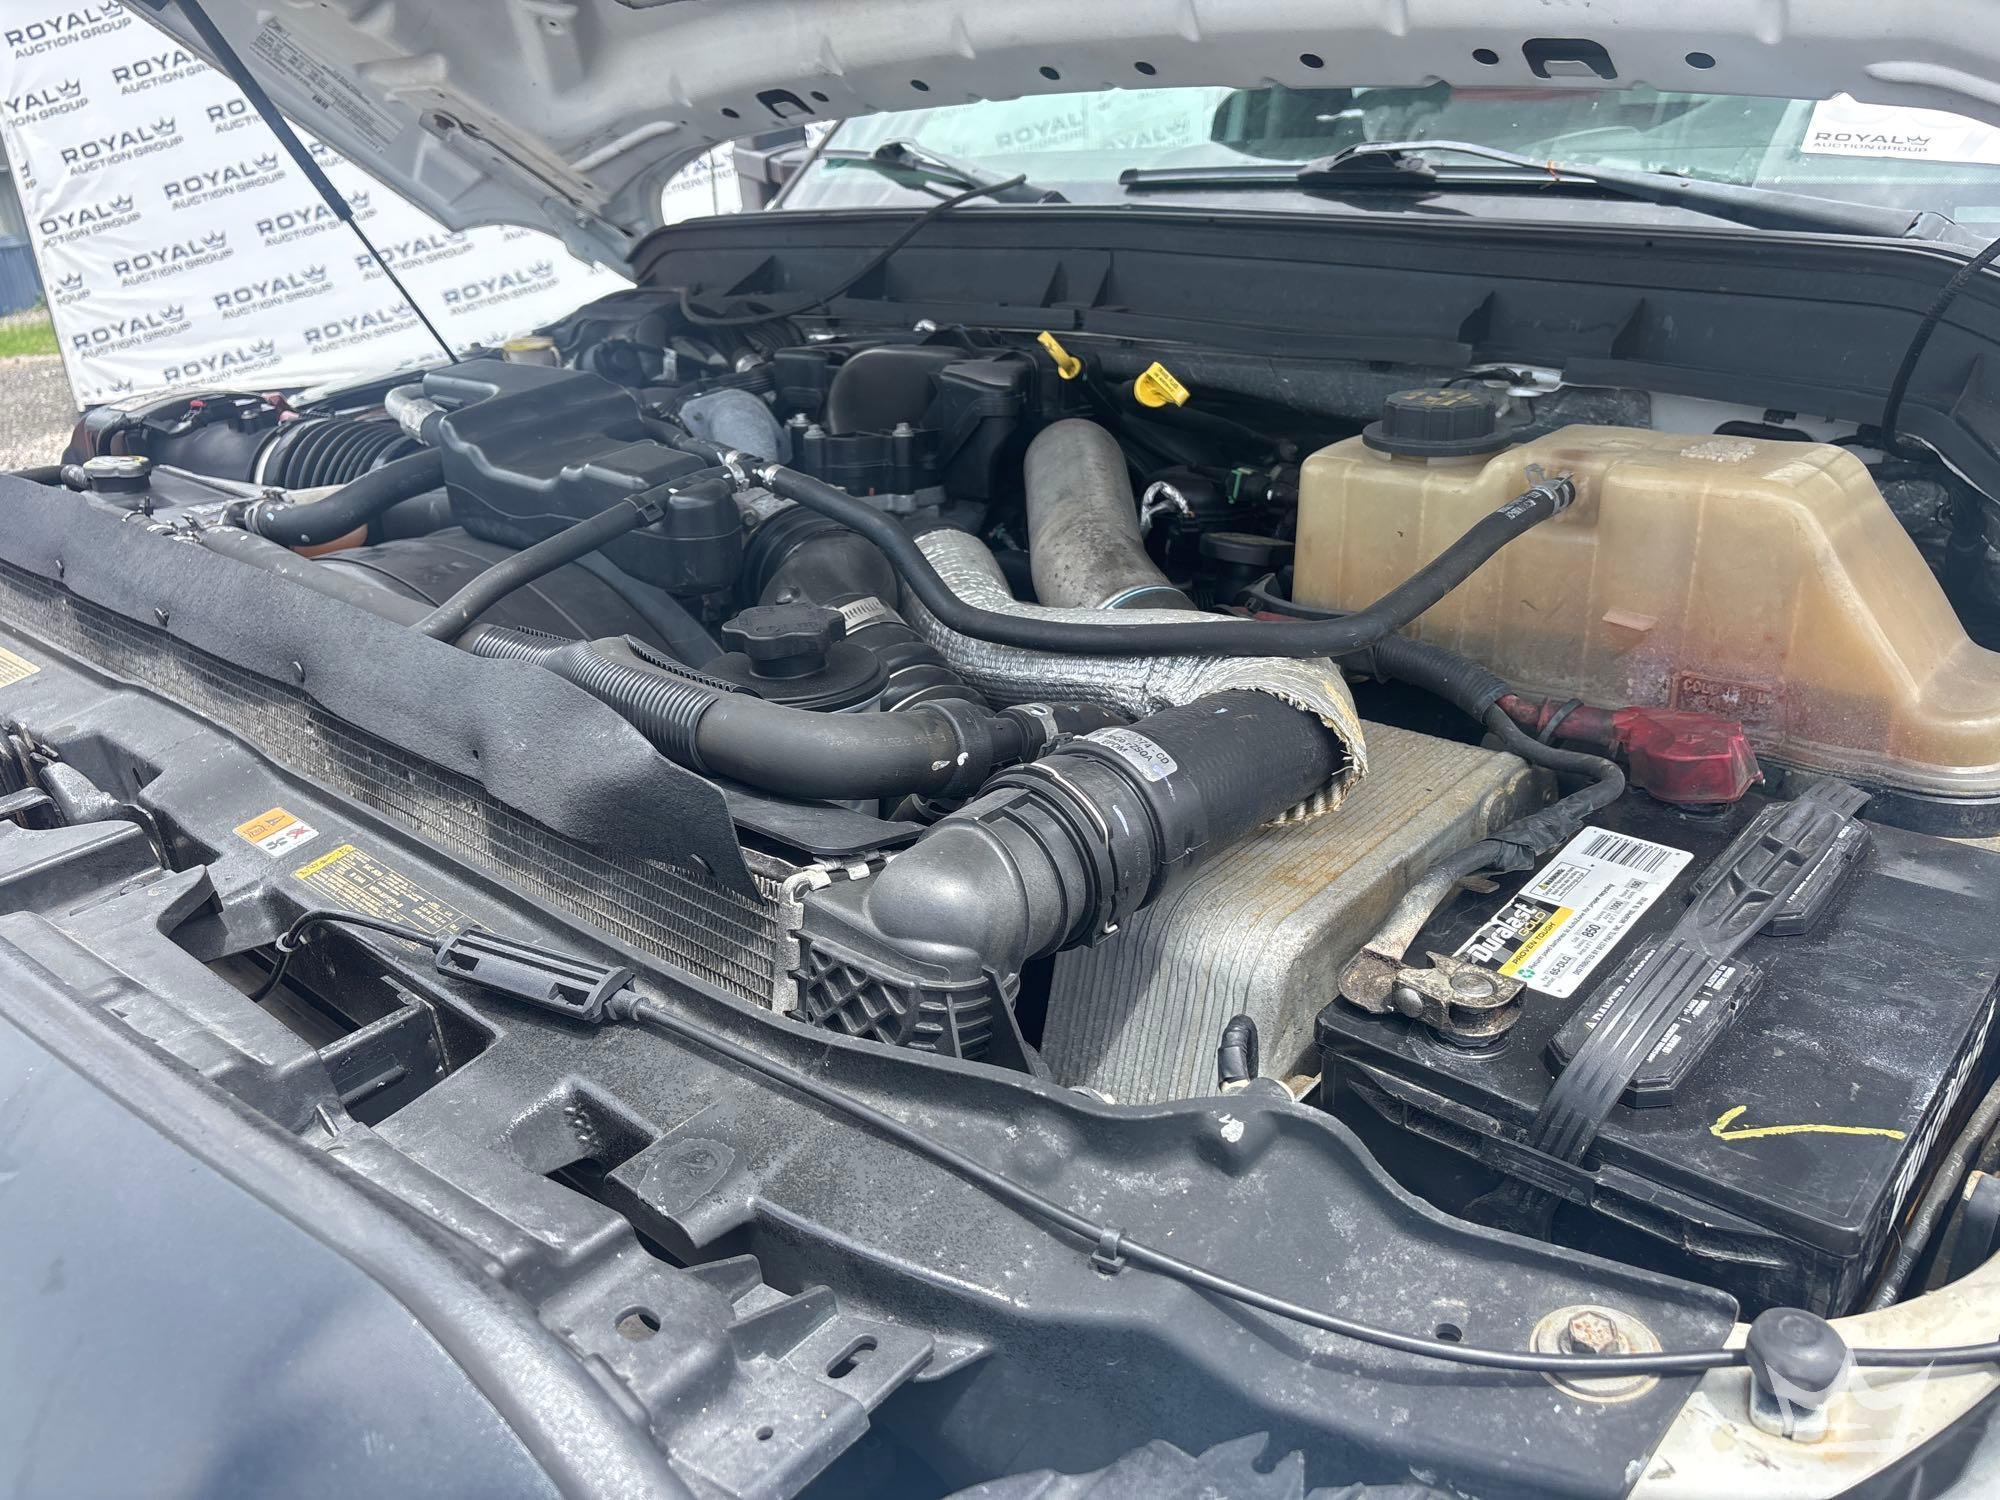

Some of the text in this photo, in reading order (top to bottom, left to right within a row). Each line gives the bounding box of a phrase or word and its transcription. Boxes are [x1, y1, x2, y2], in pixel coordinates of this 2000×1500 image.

[5, 8, 100, 47] ROYAL
[15, 17, 132, 59] AUCTION GROUP
[112, 50, 200, 83] ROYA
[121, 69, 184, 96] AUCTION
[5, 88, 59, 114] YAL
[39, 97, 89, 121] GROUP
[61, 126, 154, 165] ROYAL
[1813, 142, 1928, 153] AUCTION GROUP
[1815, 132, 1904, 144] ROYAL
[70, 135, 184, 176] AUCTION GROUP
[163, 162, 256, 200] ROYAL
[172, 184, 235, 211] AUCTION
[40, 204, 112, 236] OYAL
[256, 203, 332, 236] ROYA
[113, 240, 205, 277] ROYAL
[355, 234, 446, 271] ROYAL
[122, 262, 183, 288] AUCTION
[214, 273, 304, 309] ROYAL
[442, 268, 532, 305] ROYAL
[222, 295, 284, 320] AUCTION
[72, 313, 162, 350] ROYAL
[304, 308, 394, 344] ROYAL
[164, 347, 254, 384] ROYAL
[1156, 752, 1170, 765] CD
[1467, 902, 1537, 963] Duralast
[1518, 911, 1547, 936] GOLD
[1580, 923, 1602, 938] 850
[1512, 922, 1556, 965] PROVEN TOUGH
[1547, 955, 1572, 975] 65-DLG
